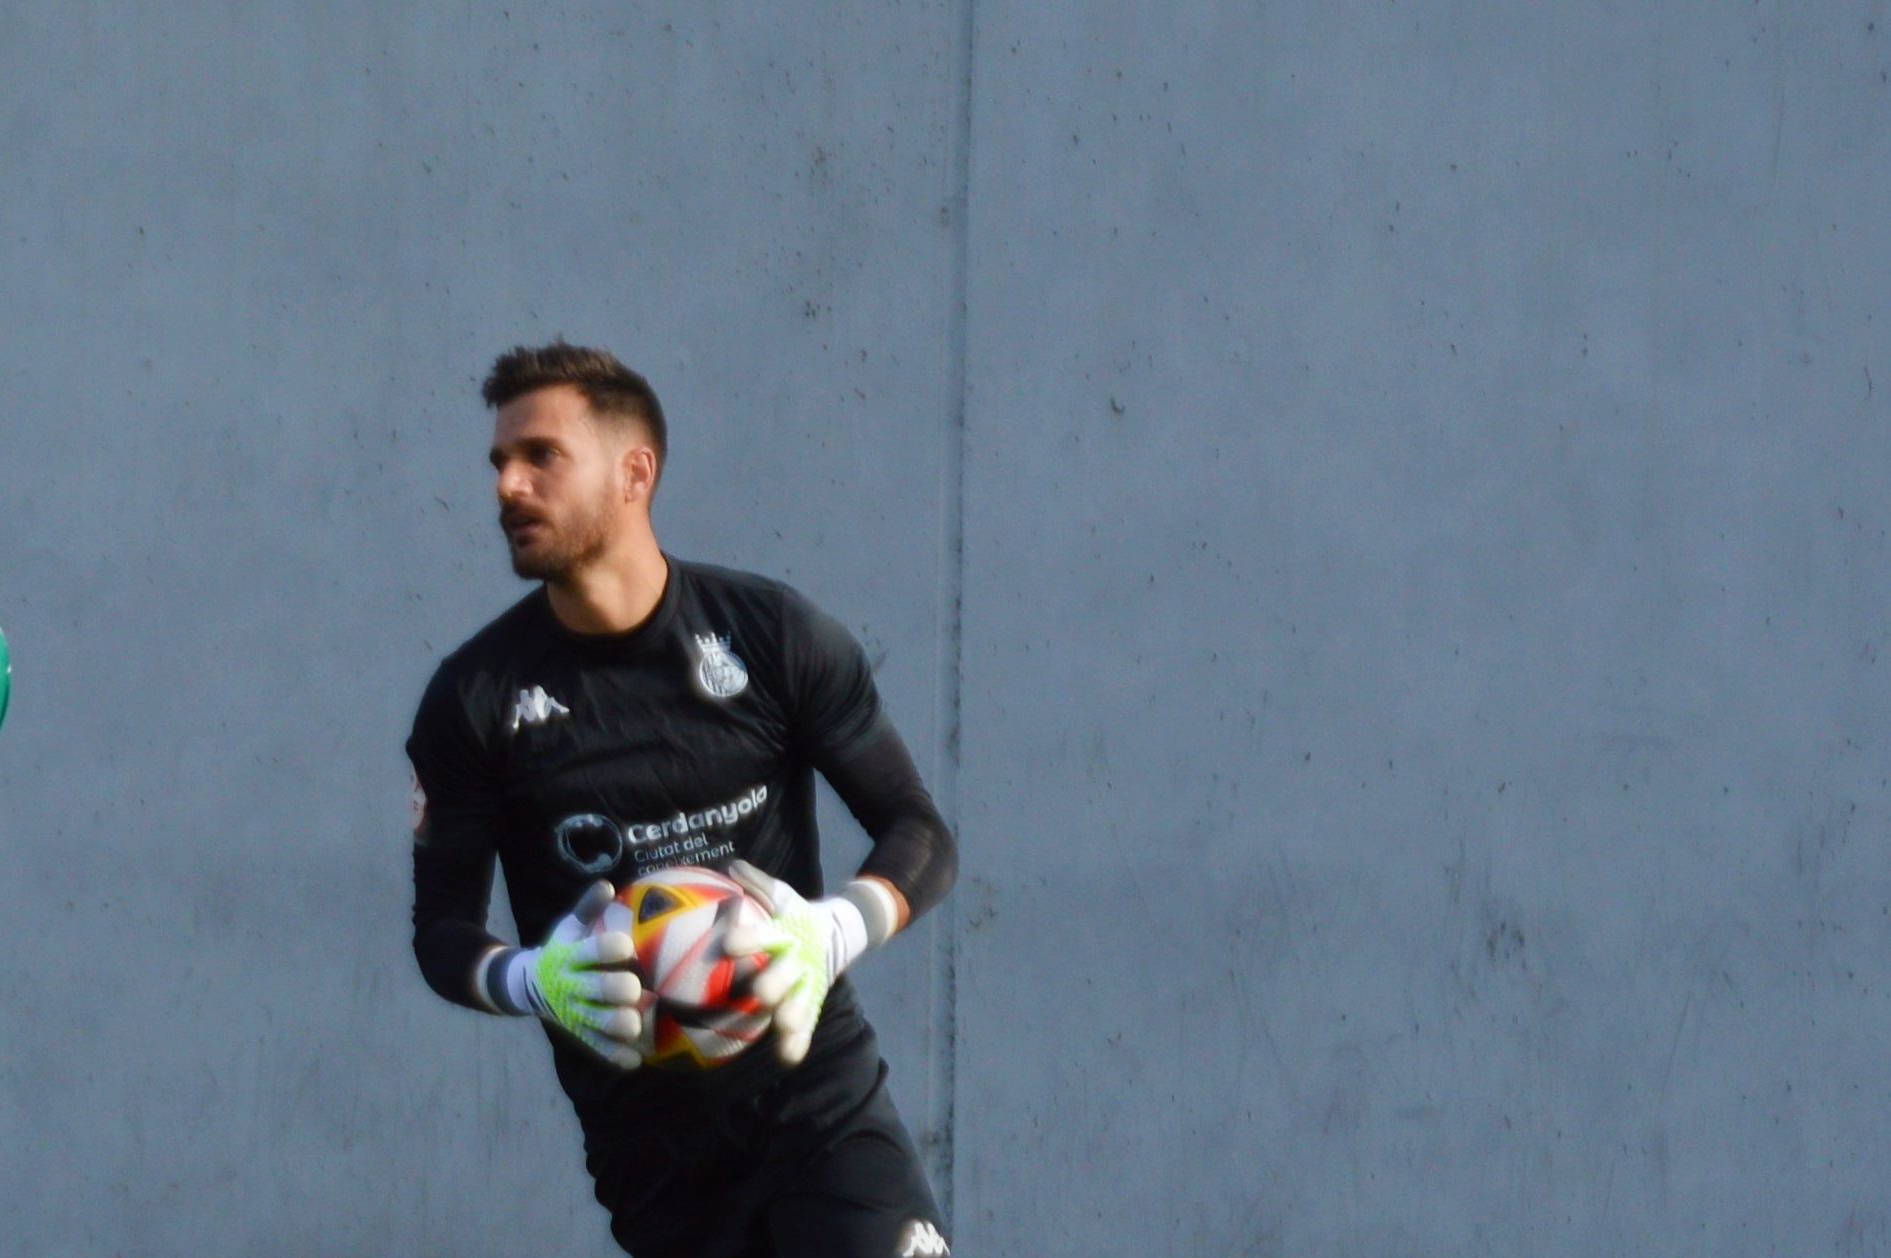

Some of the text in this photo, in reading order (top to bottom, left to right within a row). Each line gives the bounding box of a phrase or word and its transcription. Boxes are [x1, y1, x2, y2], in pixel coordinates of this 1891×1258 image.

[627, 784, 768, 844] Cerdanyola
[634, 832, 709, 863] Ciutat del
